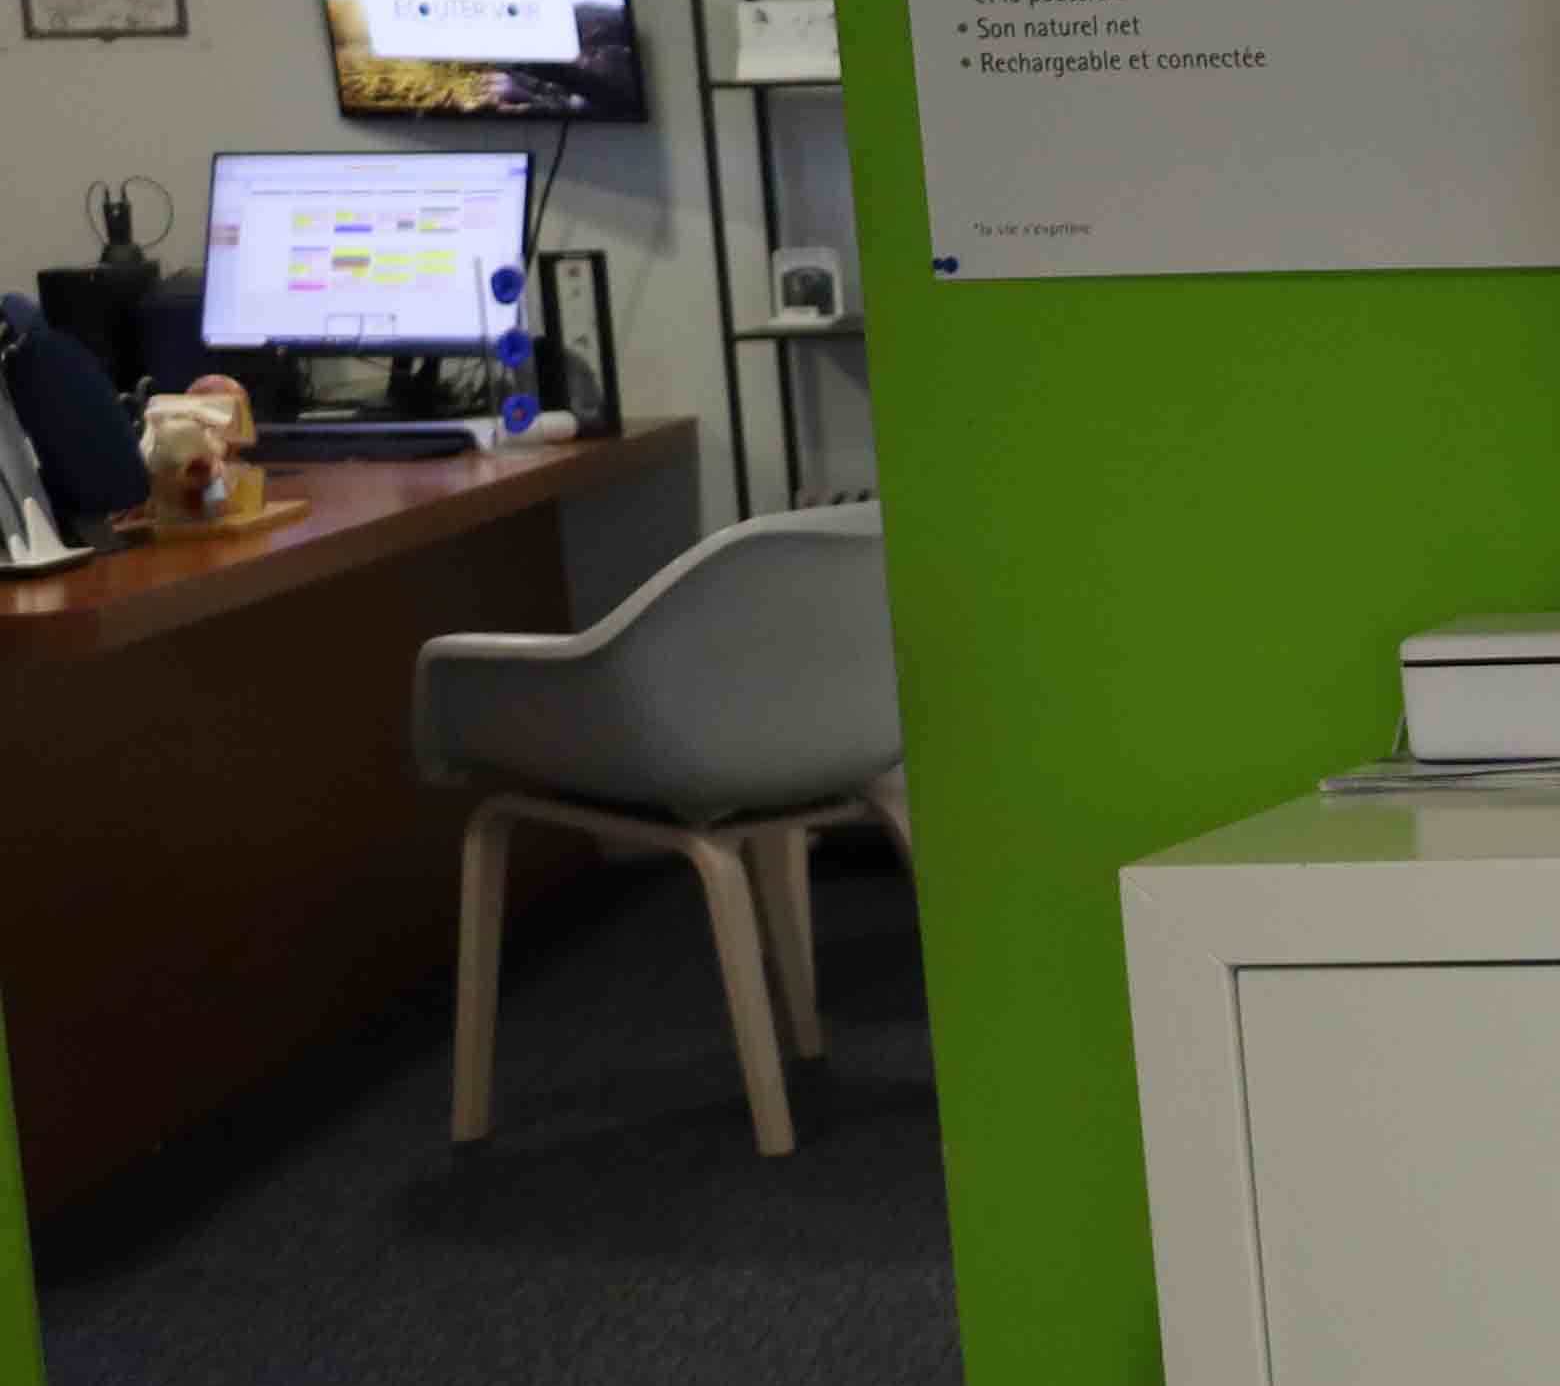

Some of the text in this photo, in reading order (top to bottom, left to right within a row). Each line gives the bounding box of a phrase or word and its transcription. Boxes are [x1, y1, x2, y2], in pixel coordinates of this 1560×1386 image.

[976, 15, 1141, 40] Son naturel net
[979, 44, 1267, 79] Rechargeable et connectée
